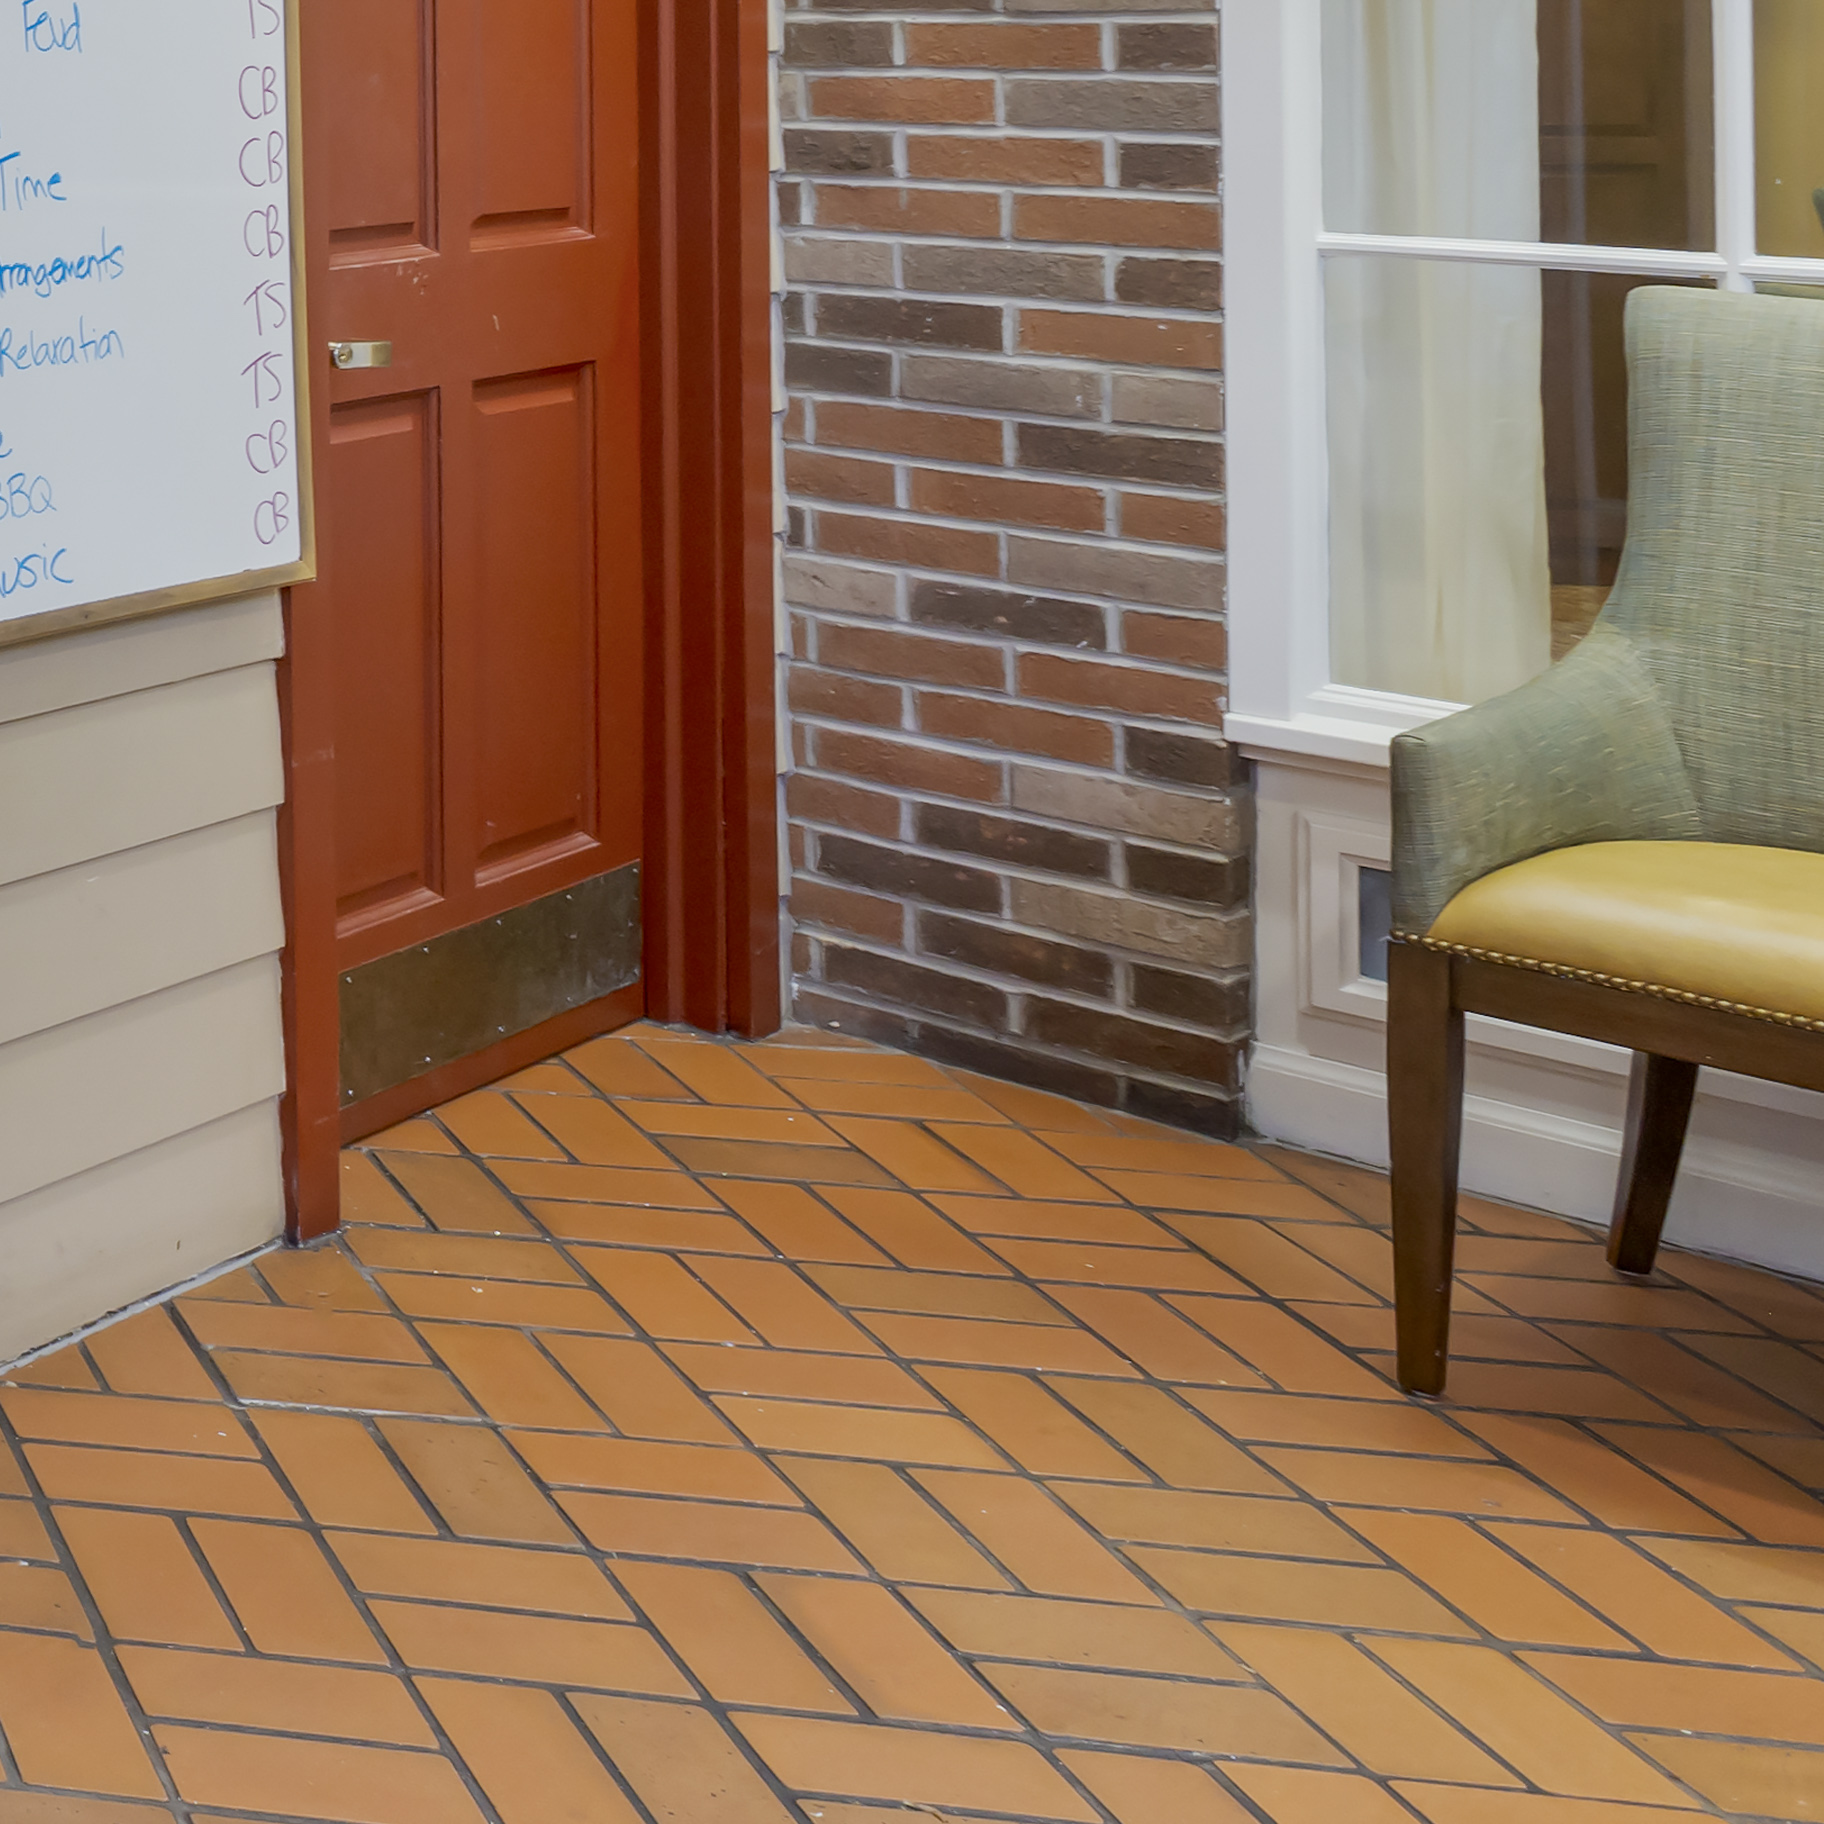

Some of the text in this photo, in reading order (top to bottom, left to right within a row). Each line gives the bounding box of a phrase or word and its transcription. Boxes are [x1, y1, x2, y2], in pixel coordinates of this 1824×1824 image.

[238, 65, 277, 119] CB
[239, 131, 283, 187] CB
[244, 204, 283, 258] CB
[243, 279, 287, 336] TS
[241, 351, 283, 408] TS
[246, 419, 287, 473] CB
[254, 491, 289, 544] CB
